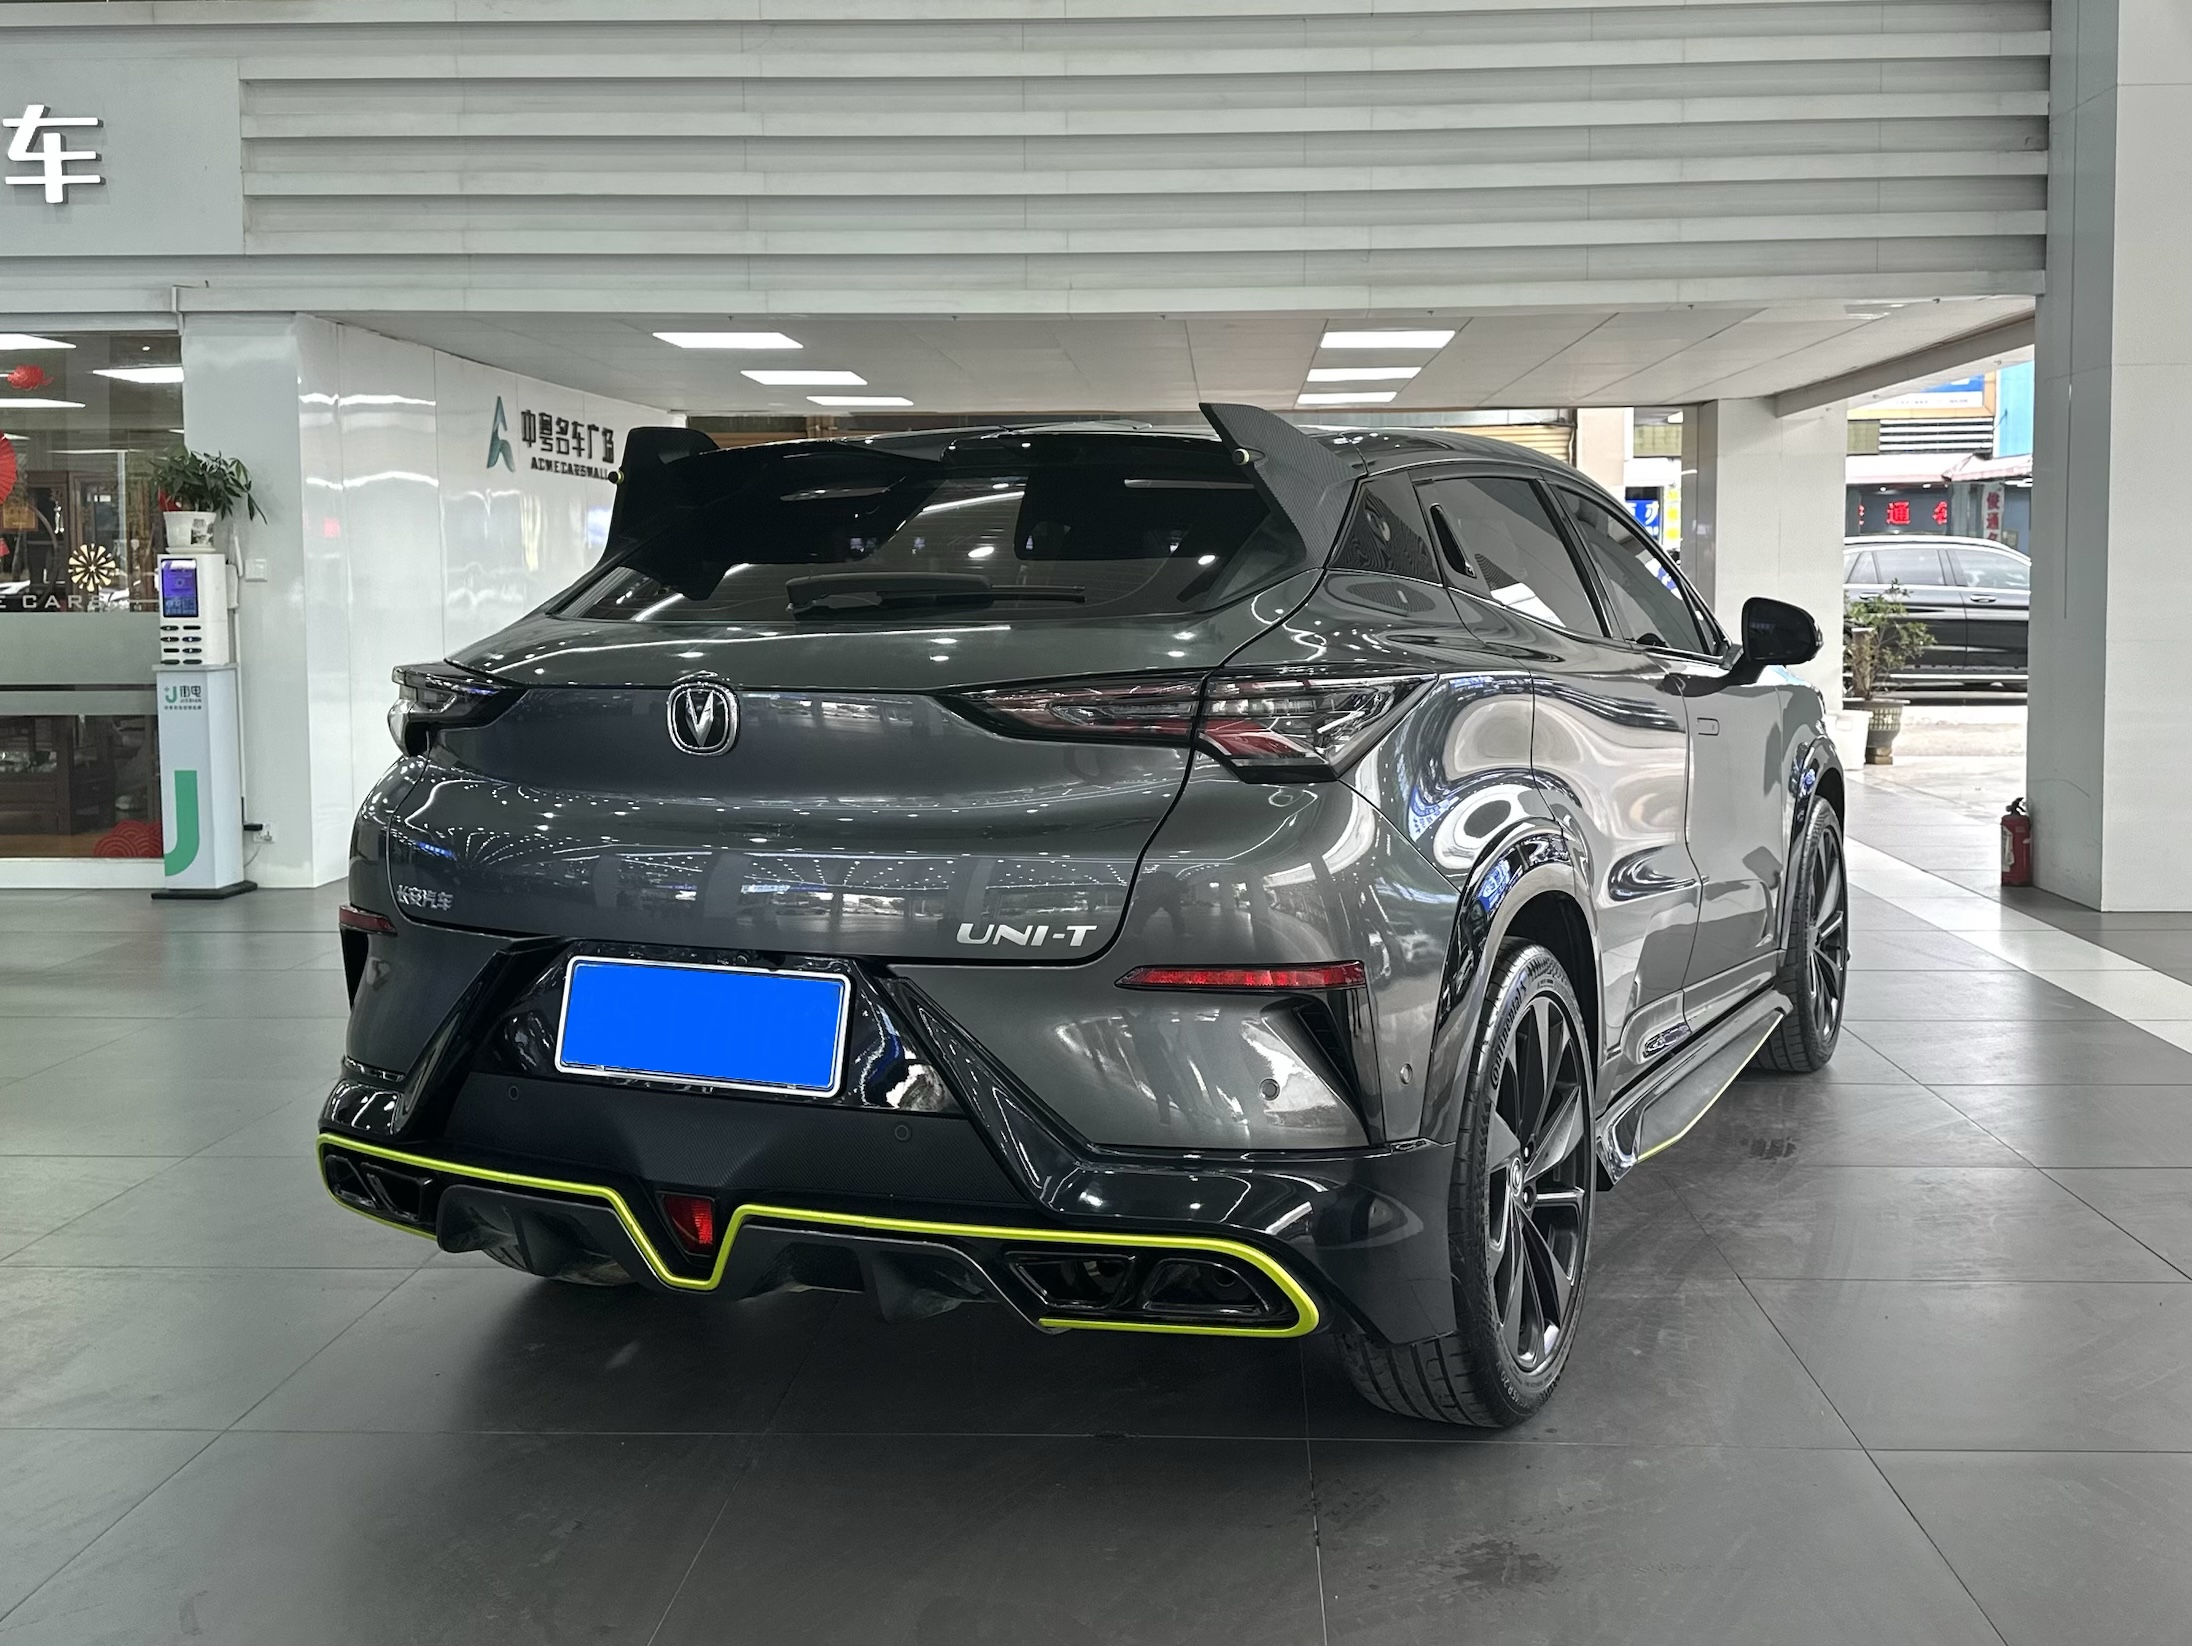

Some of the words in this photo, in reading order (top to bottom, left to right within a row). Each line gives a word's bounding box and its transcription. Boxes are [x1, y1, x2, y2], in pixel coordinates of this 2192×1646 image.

[2, 104, 104, 204] 车
[397, 885, 454, 911] 长安汽车
[956, 923, 1098, 947] UNI-T
